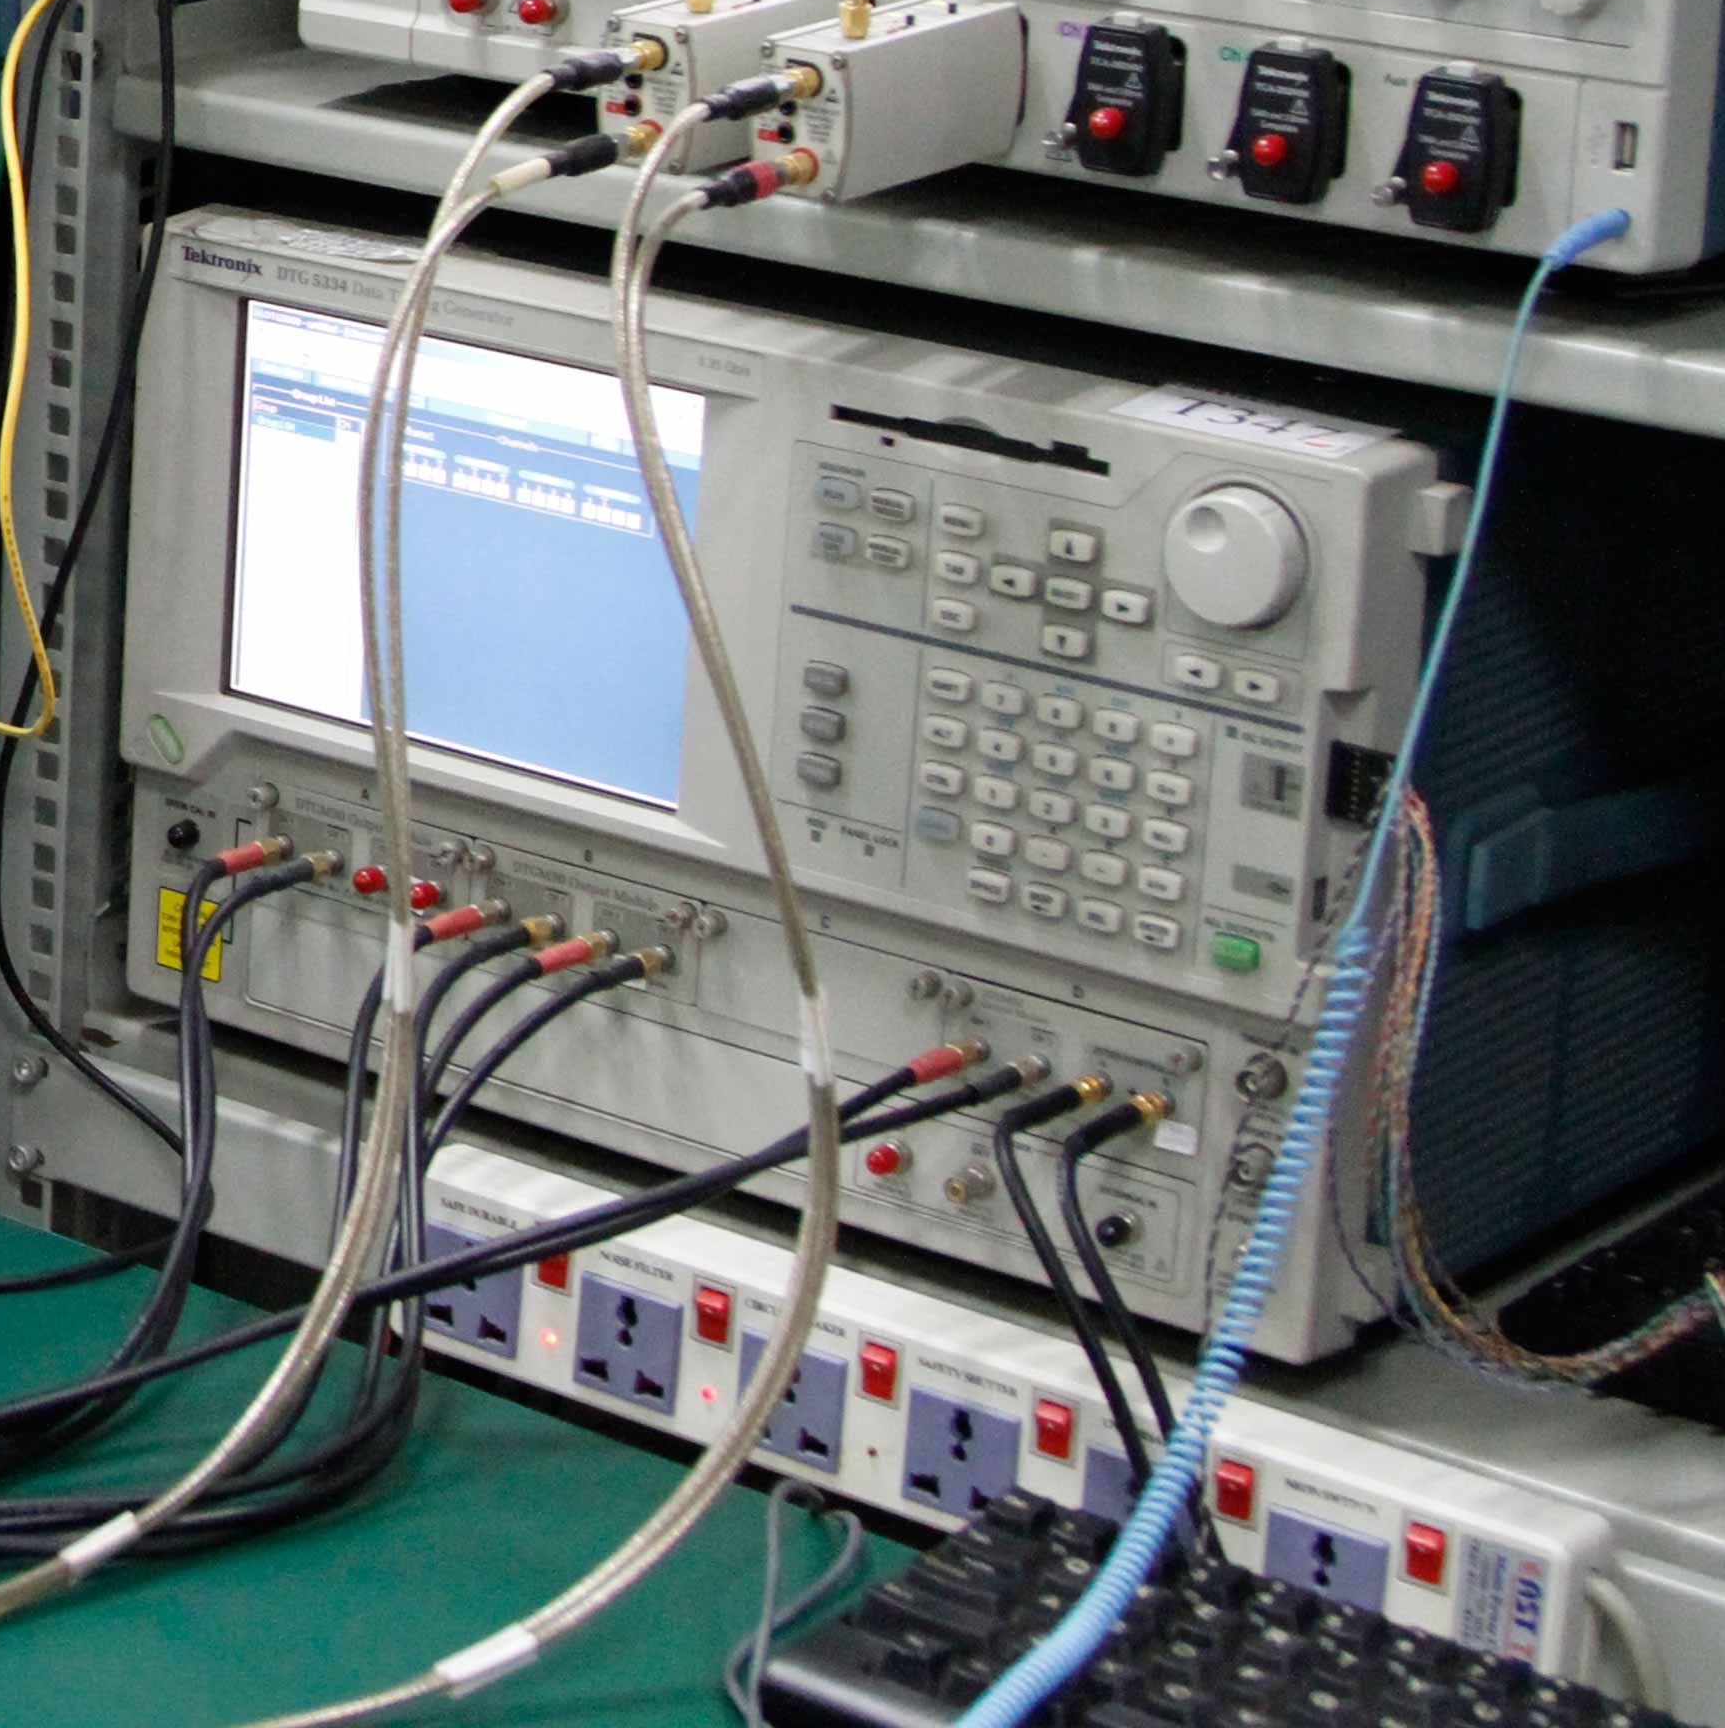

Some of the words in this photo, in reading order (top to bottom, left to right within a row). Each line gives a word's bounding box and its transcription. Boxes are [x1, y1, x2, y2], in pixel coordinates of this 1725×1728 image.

[181, 245, 263, 278] Tektronix
[276, 265, 309, 285] DTG
[311, 271, 348, 293] 5334
[352, 279, 384, 298] Data
[442, 300, 516, 328] Generator
[361, 787, 371, 801] A
[583, 848, 593, 864] B
[820, 915, 831, 929] C
[1072, 984, 1085, 999] D
[440, 1195, 468, 1215] SAFE
[468, 1204, 519, 1230] DURABLE
[600, 1248, 631, 1268] NOISE
[630, 1259, 675, 1283] FILTER
[916, 1355, 961, 1378] SAFETY
[961, 1370, 1020, 1400] SHUTTER
